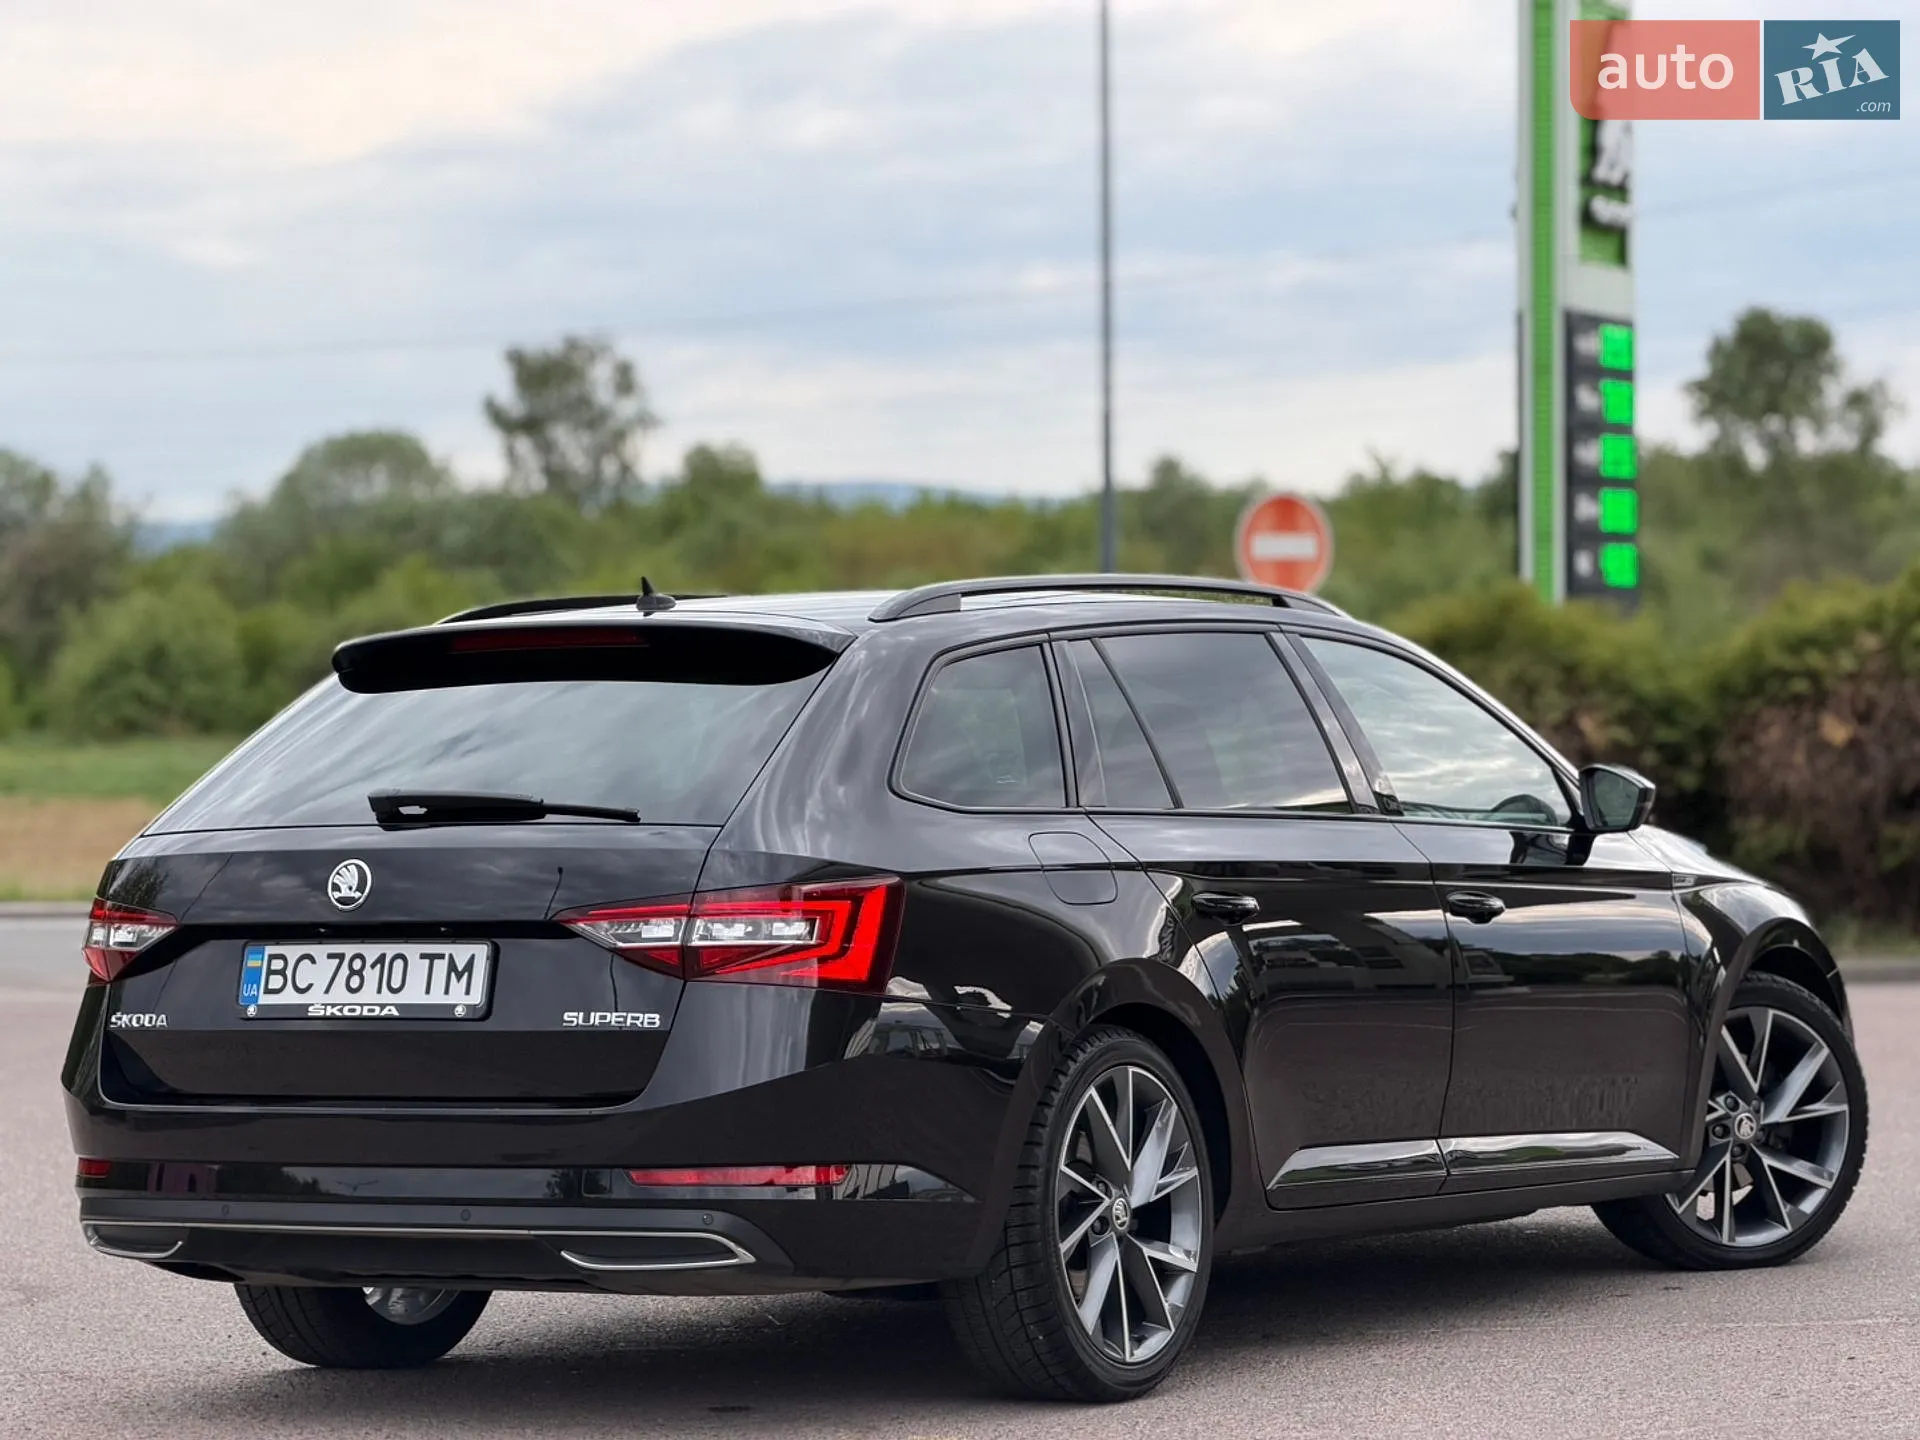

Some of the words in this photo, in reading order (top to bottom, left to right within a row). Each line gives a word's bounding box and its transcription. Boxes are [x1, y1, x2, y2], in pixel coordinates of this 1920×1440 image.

[263, 952, 318, 995] BC
[323, 952, 410, 996] 7810
[419, 952, 476, 996] TM
[243, 984, 259, 998] UA
[562, 1011, 661, 1028] SUPERB
